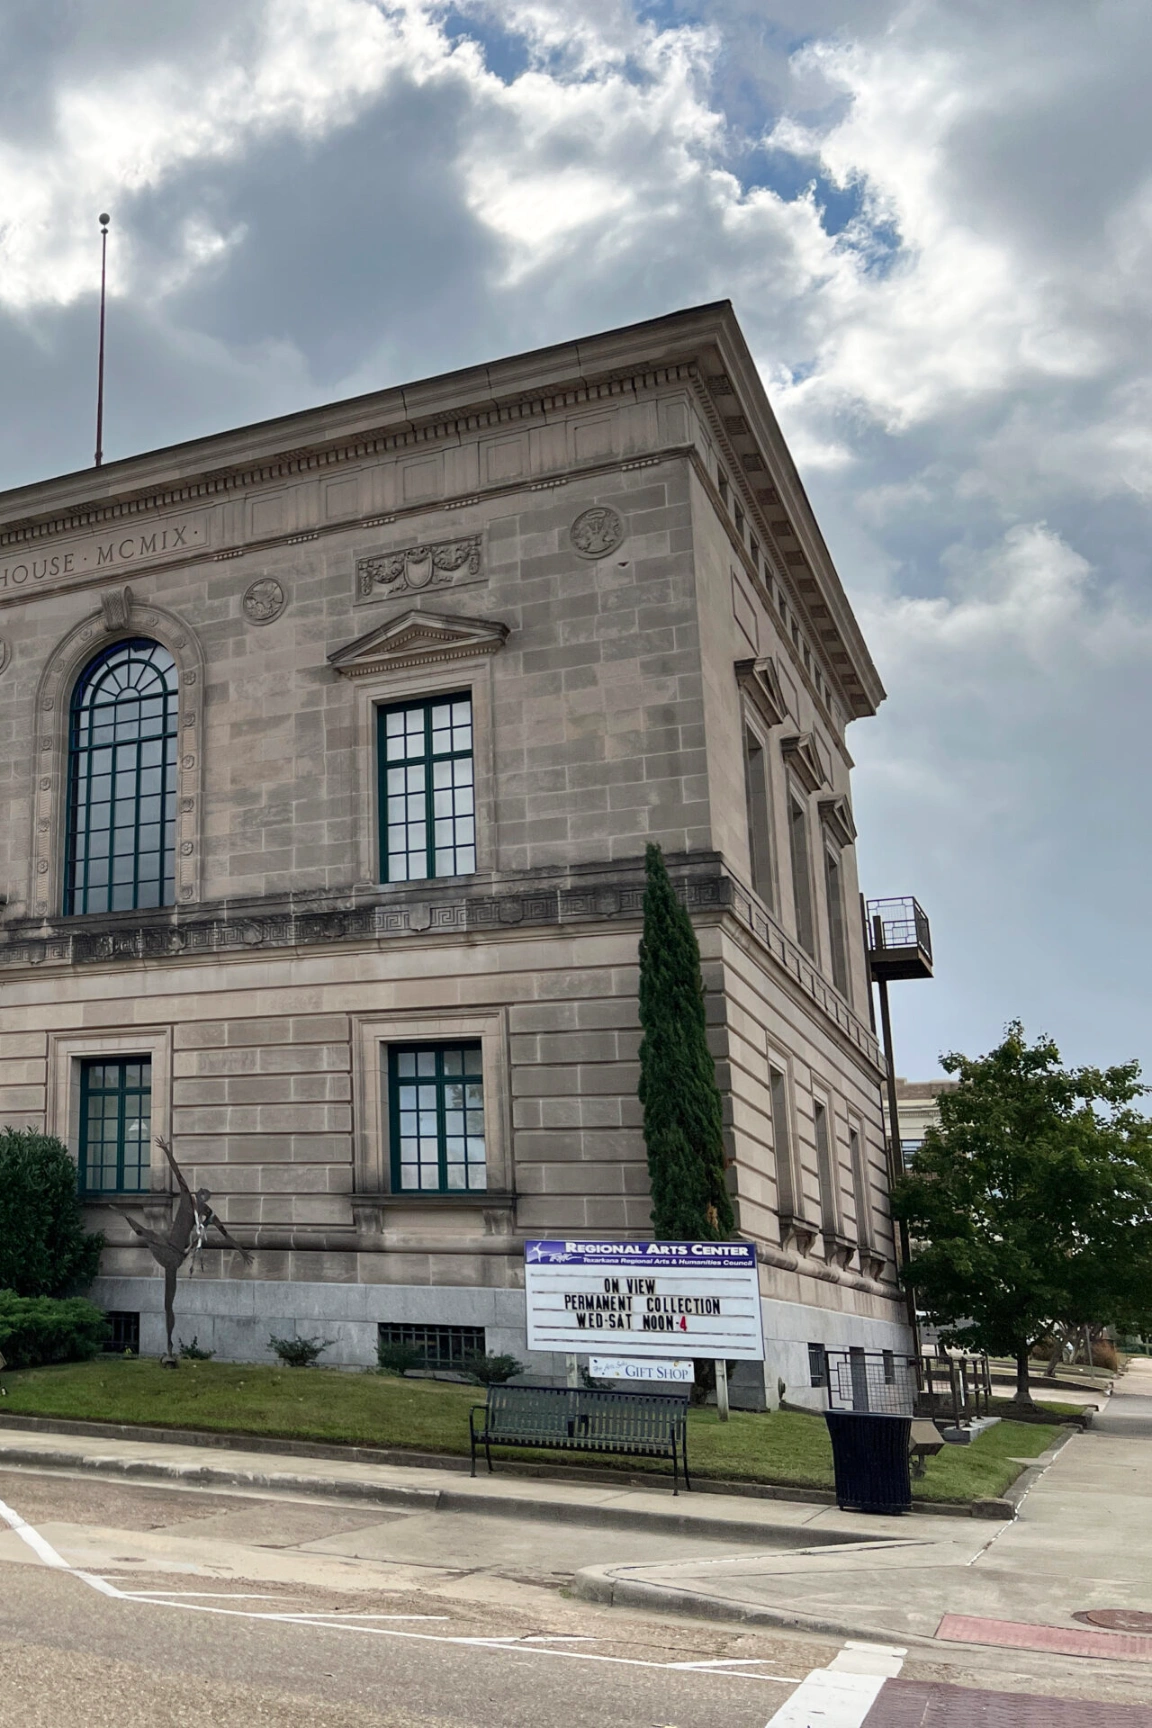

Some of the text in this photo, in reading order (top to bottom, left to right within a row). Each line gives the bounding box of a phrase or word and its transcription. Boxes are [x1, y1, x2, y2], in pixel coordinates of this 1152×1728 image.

[565, 1242, 749, 1256] REGIONAL ARTS CENTER
[620, 1257, 653, 1265] Regional
[604, 1278, 656, 1294] ON VIEW
[564, 1294, 721, 1314] PERMANENT COLLECTION
[576, 1312, 687, 1332] WED-SAT NOON-4
[625, 1364, 653, 1378] GIFT
[656, 1366, 689, 1380] SHOP
